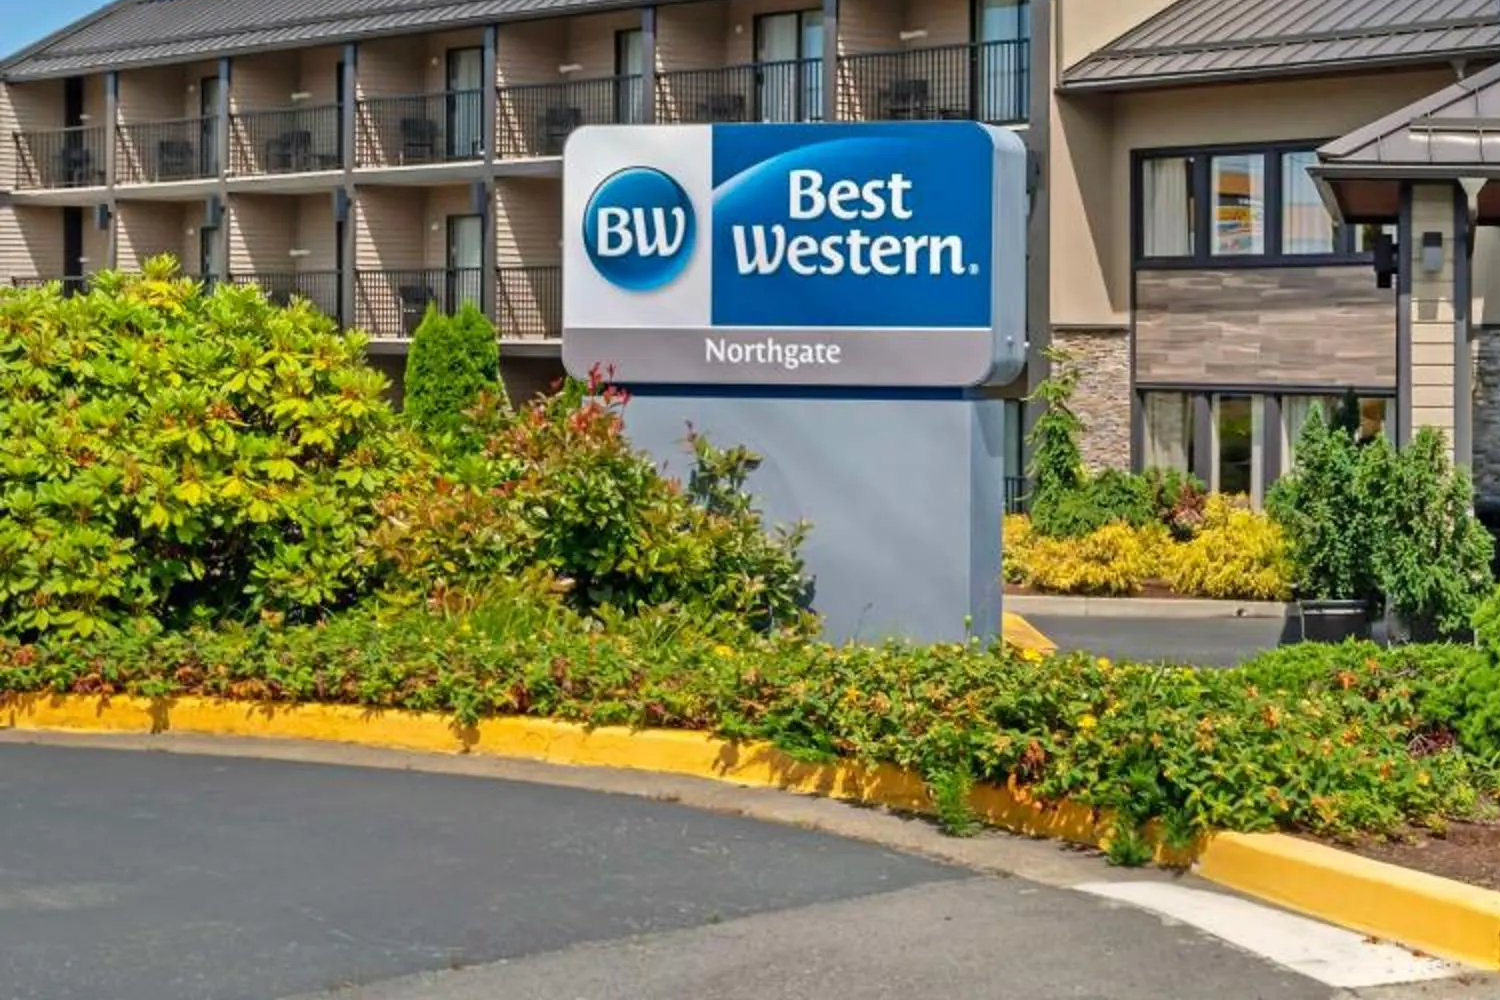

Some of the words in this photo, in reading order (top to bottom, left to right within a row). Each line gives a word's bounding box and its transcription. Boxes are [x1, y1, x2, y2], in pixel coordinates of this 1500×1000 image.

[789, 169, 912, 220] Best
[597, 206, 686, 258] BW
[732, 225, 966, 275] Western
[705, 338, 841, 369] Northgate
